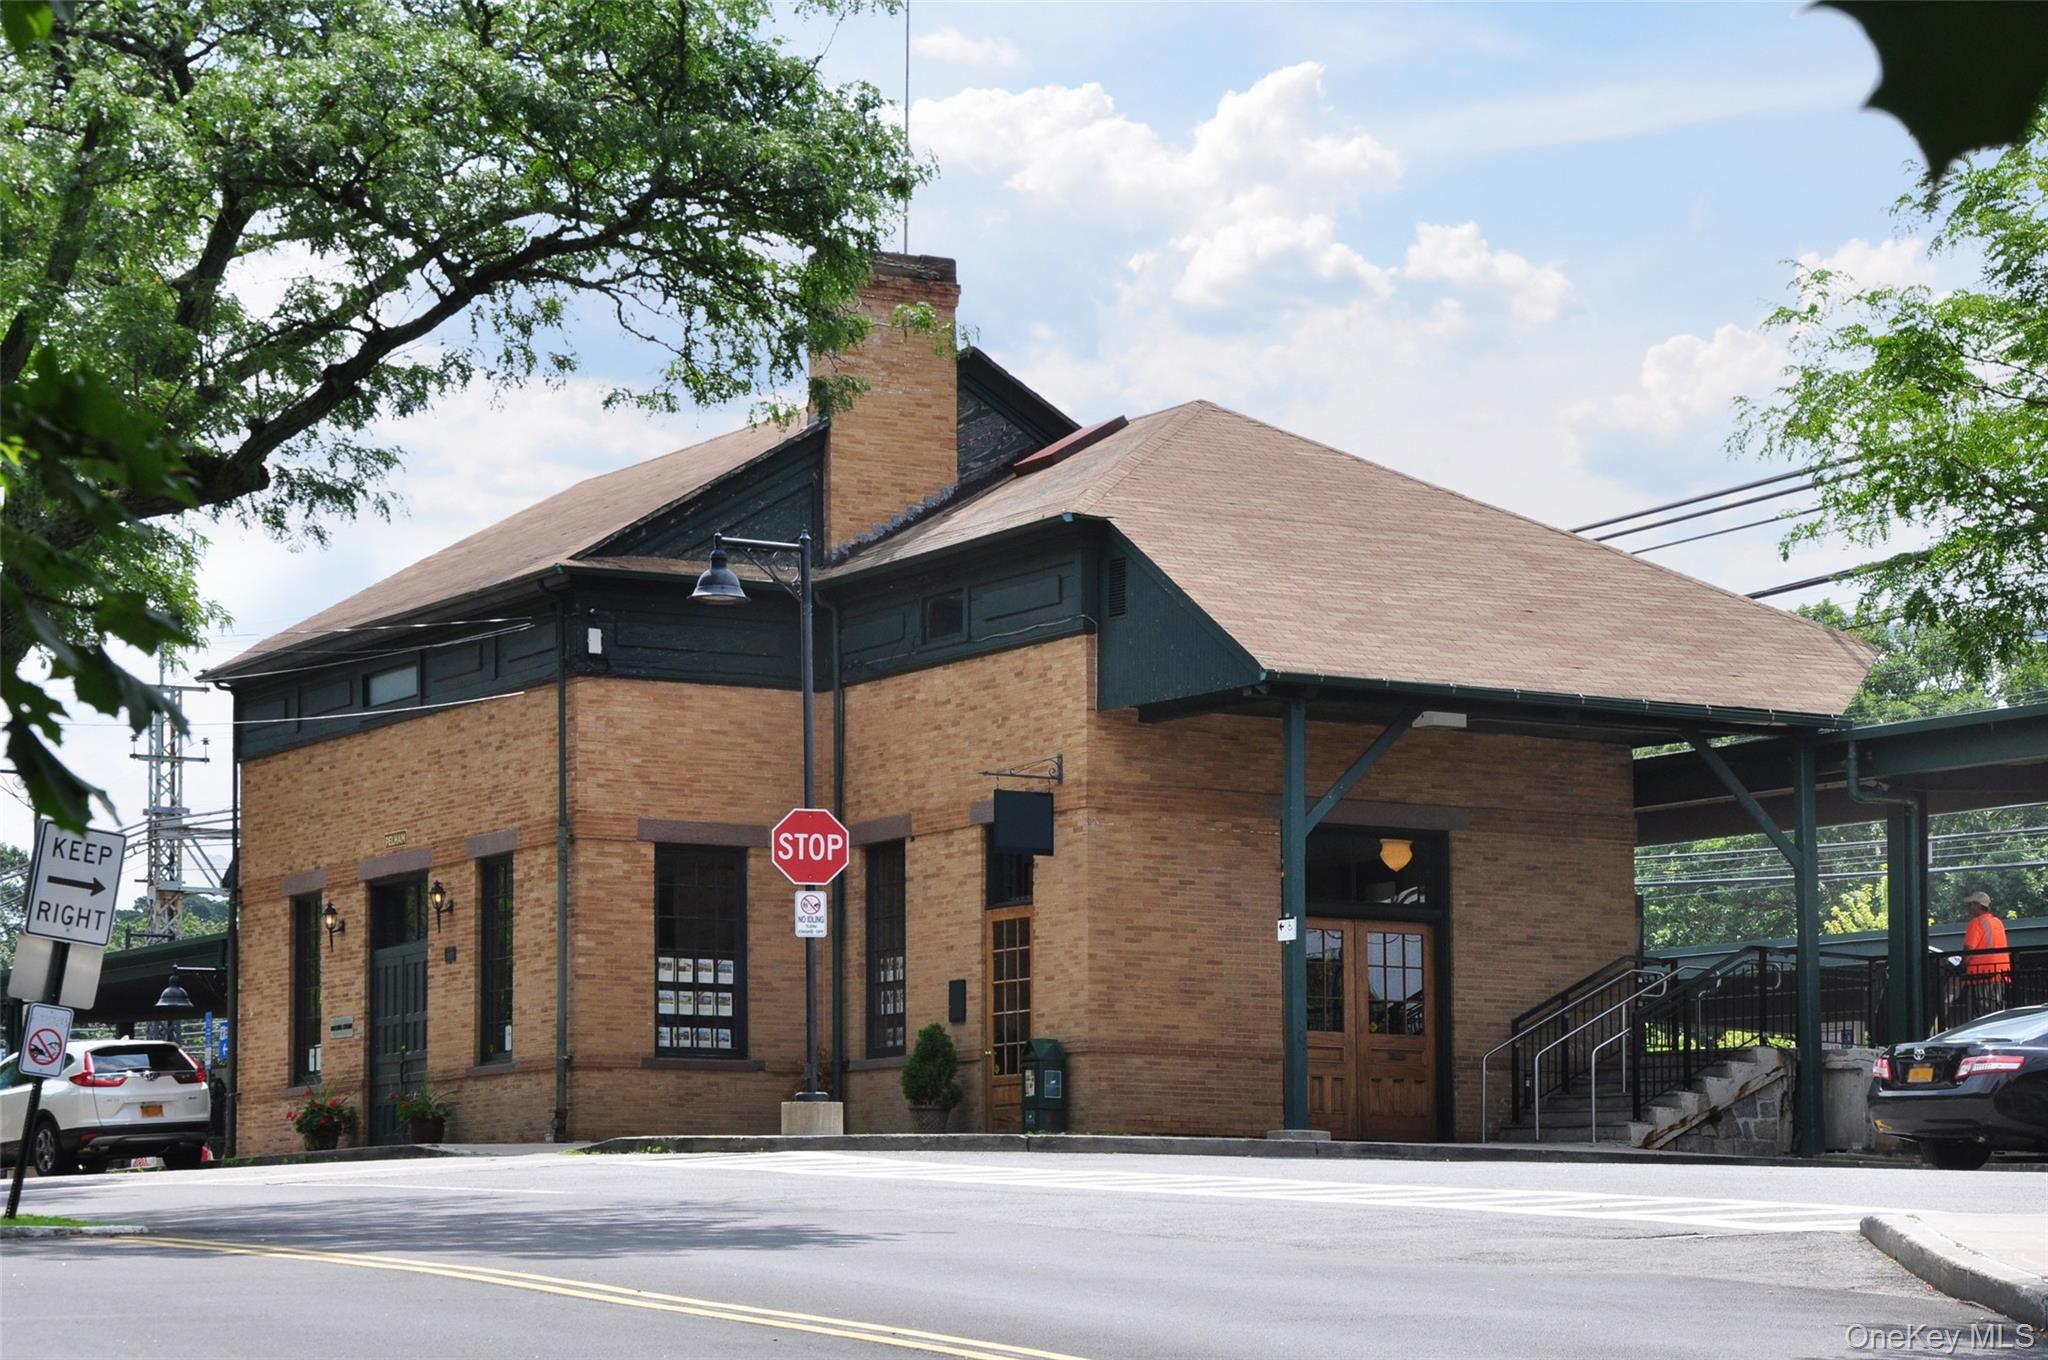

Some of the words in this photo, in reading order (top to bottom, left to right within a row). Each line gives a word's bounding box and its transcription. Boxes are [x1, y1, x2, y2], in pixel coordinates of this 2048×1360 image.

[52, 837, 113, 865] KEEP
[778, 832, 843, 861] STOP
[36, 900, 106, 930] RIGHT
[798, 915, 806, 923] NO
[807, 915, 825, 924] IDLING
